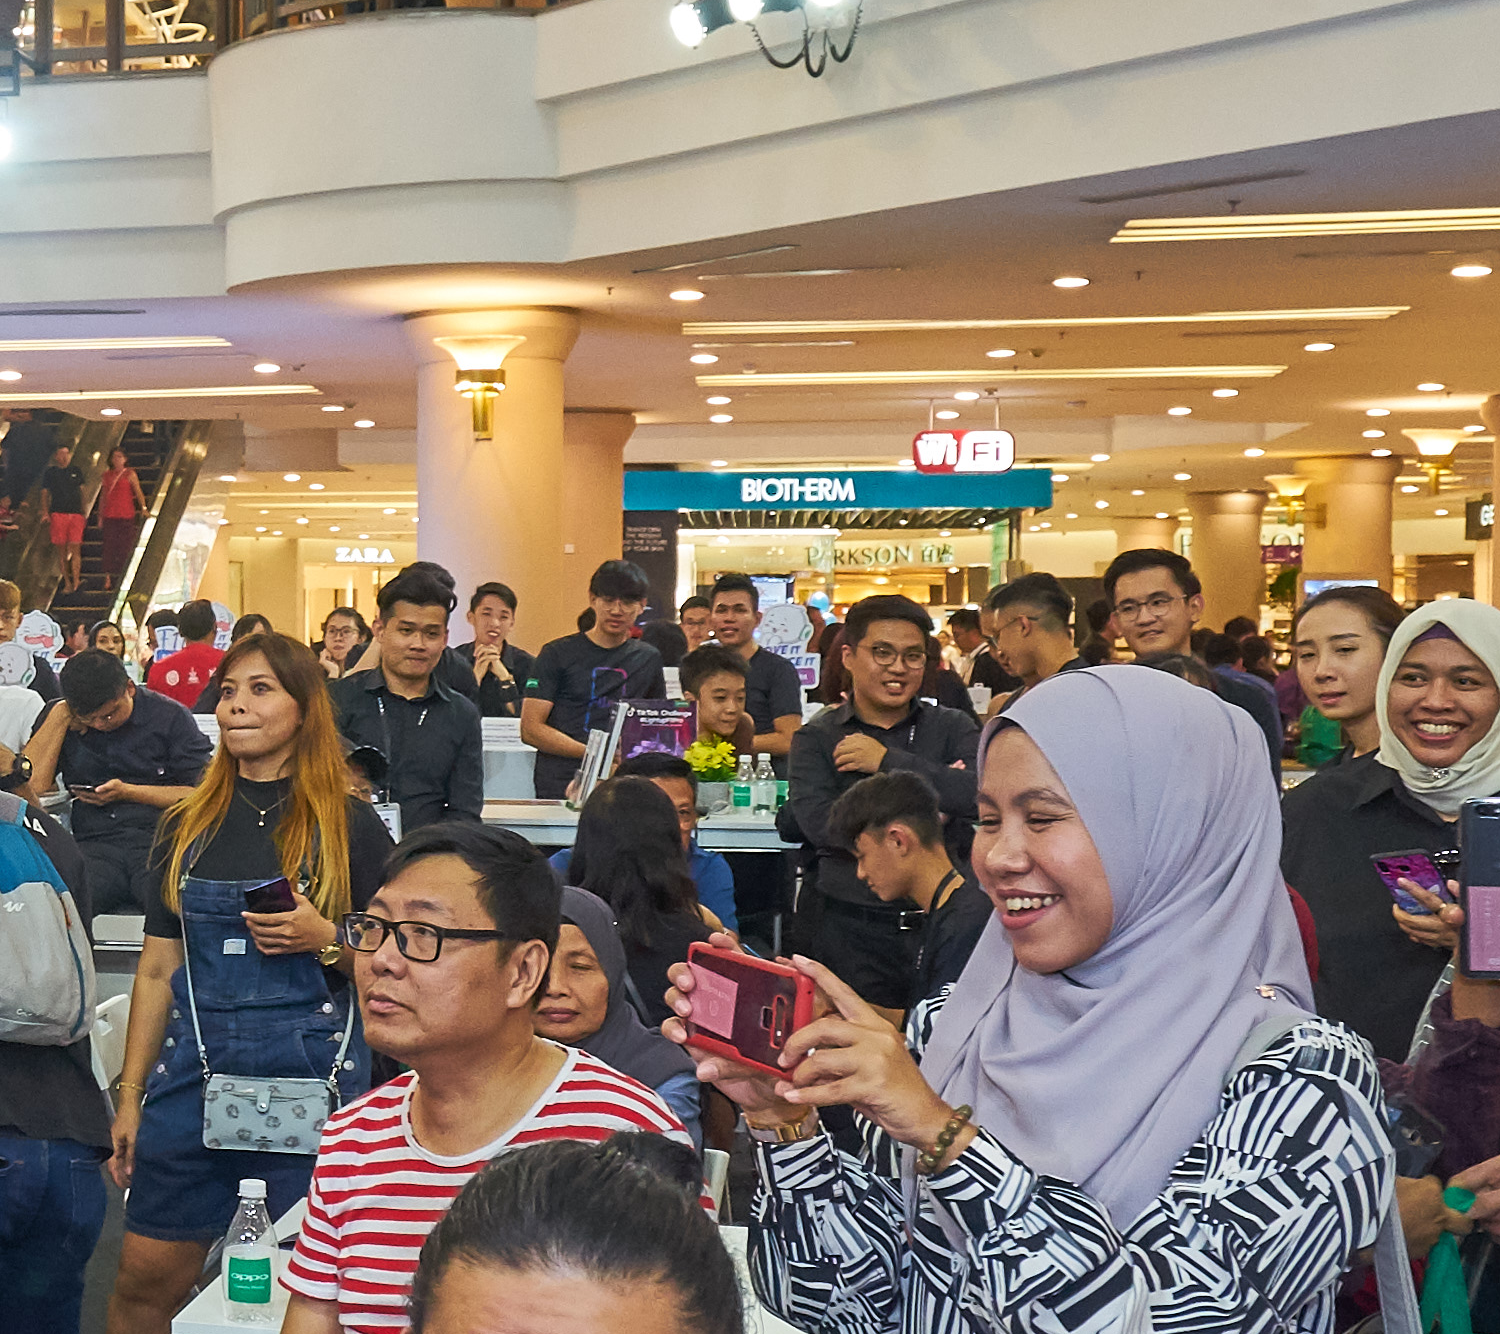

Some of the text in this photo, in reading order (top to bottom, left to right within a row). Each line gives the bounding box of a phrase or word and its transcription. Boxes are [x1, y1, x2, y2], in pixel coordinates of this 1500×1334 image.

[740, 477, 856, 503] BIOTHERM
[335, 547, 395, 563] ZARA
[804, 545, 910, 567] PARKSON
[230, 1272, 269, 1282] oppo
